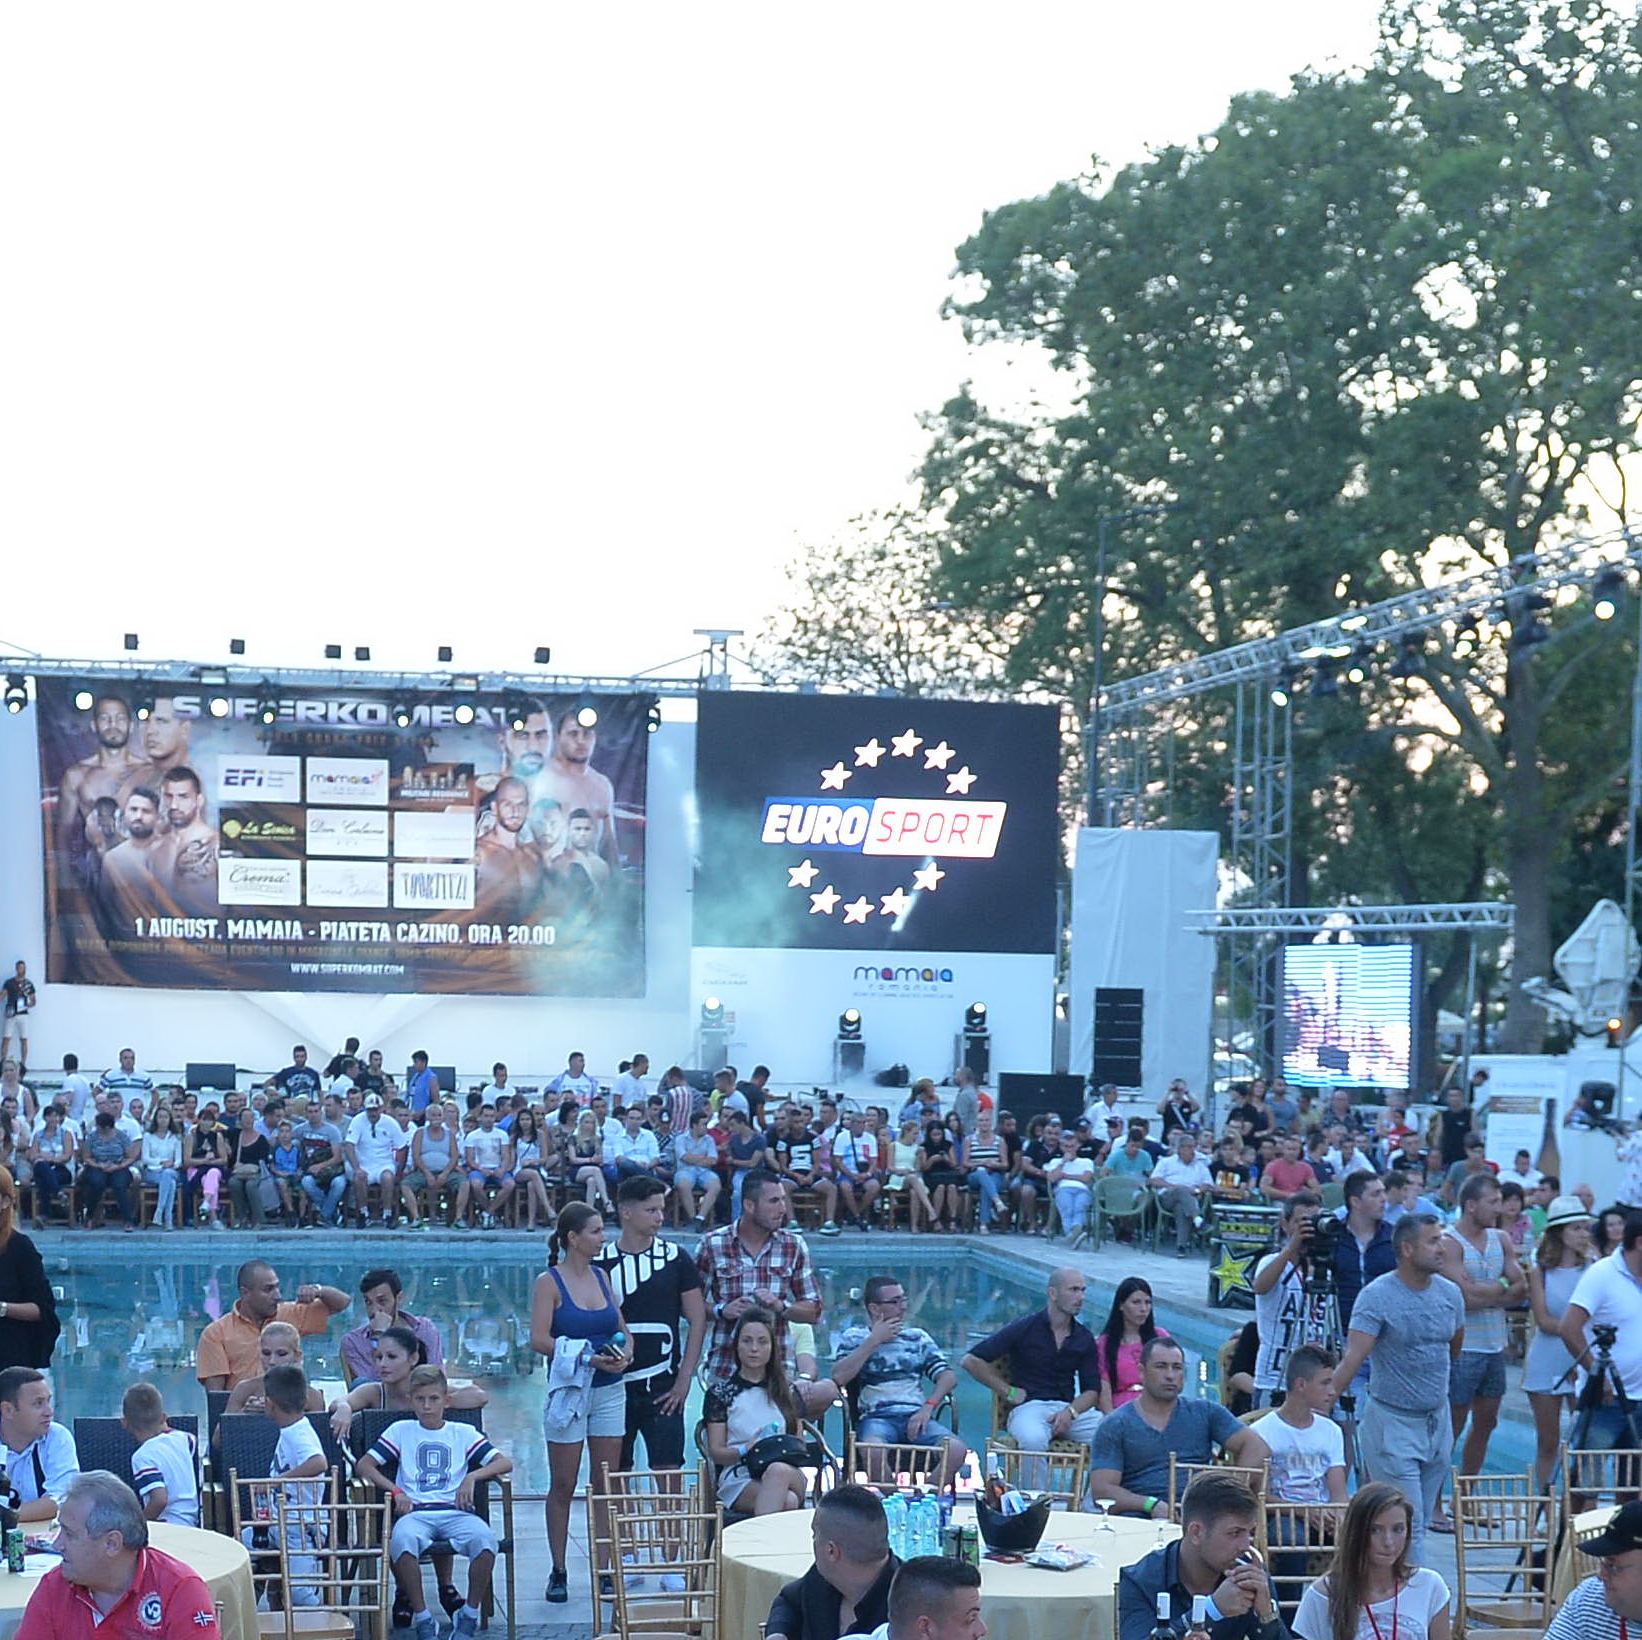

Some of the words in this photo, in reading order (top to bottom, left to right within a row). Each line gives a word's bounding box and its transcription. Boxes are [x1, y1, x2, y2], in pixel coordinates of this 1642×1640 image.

[761, 803, 994, 846] EUROSPORT
[135, 917, 144, 937] 1
[226, 919, 303, 941] MAMAIA
[319, 920, 391, 943] PIATETA
[467, 924, 503, 945] ORA
[507, 925, 556, 946] 20.00
[853, 965, 954, 984] mamaia
[415, 1441, 452, 1492] 8
